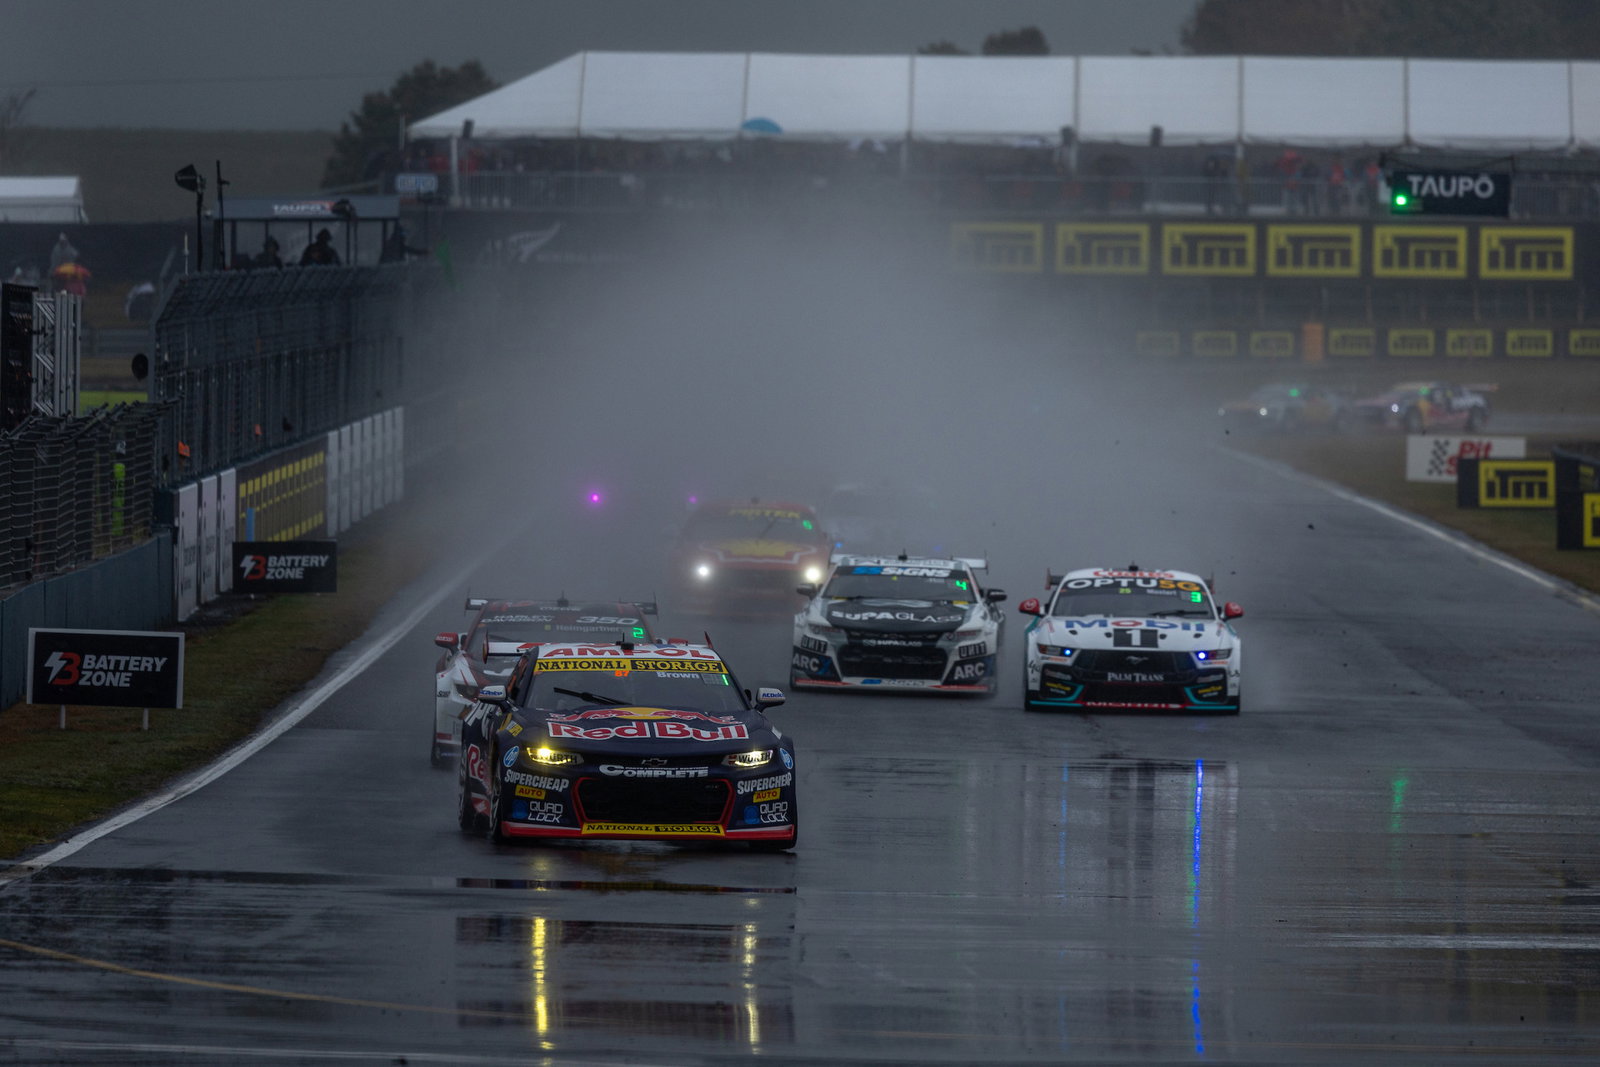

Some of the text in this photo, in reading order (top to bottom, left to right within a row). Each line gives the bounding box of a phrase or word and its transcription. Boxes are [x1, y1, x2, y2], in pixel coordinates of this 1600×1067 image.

[266, 554, 330, 568] BATTERY
[265, 567, 304, 580] ZONE
[1065, 619, 1205, 632] Mobil
[1125, 629, 1141, 646] 1
[543, 647, 715, 660] AMPOL
[82, 654, 168, 672] BATTERY
[537, 660, 719, 672] NATIONAL STORAGE
[656, 671, 701, 680] Brown
[953, 661, 985, 680] ARC
[78, 671, 133, 687] ZONE
[547, 721, 749, 742] Red Bull
[599, 764, 709, 778] COMPLETE
[503, 769, 570, 793] SUPERCHEAP
[518, 787, 543, 798] AUTO
[755, 790, 778, 800] AUTO
[529, 800, 564, 815] QUAD
[760, 801, 788, 814] QUAD
[527, 812, 562, 824] LOCK
[760, 812, 788, 824] LOCK
[586, 824, 718, 834] NATIONAL STORAGE
